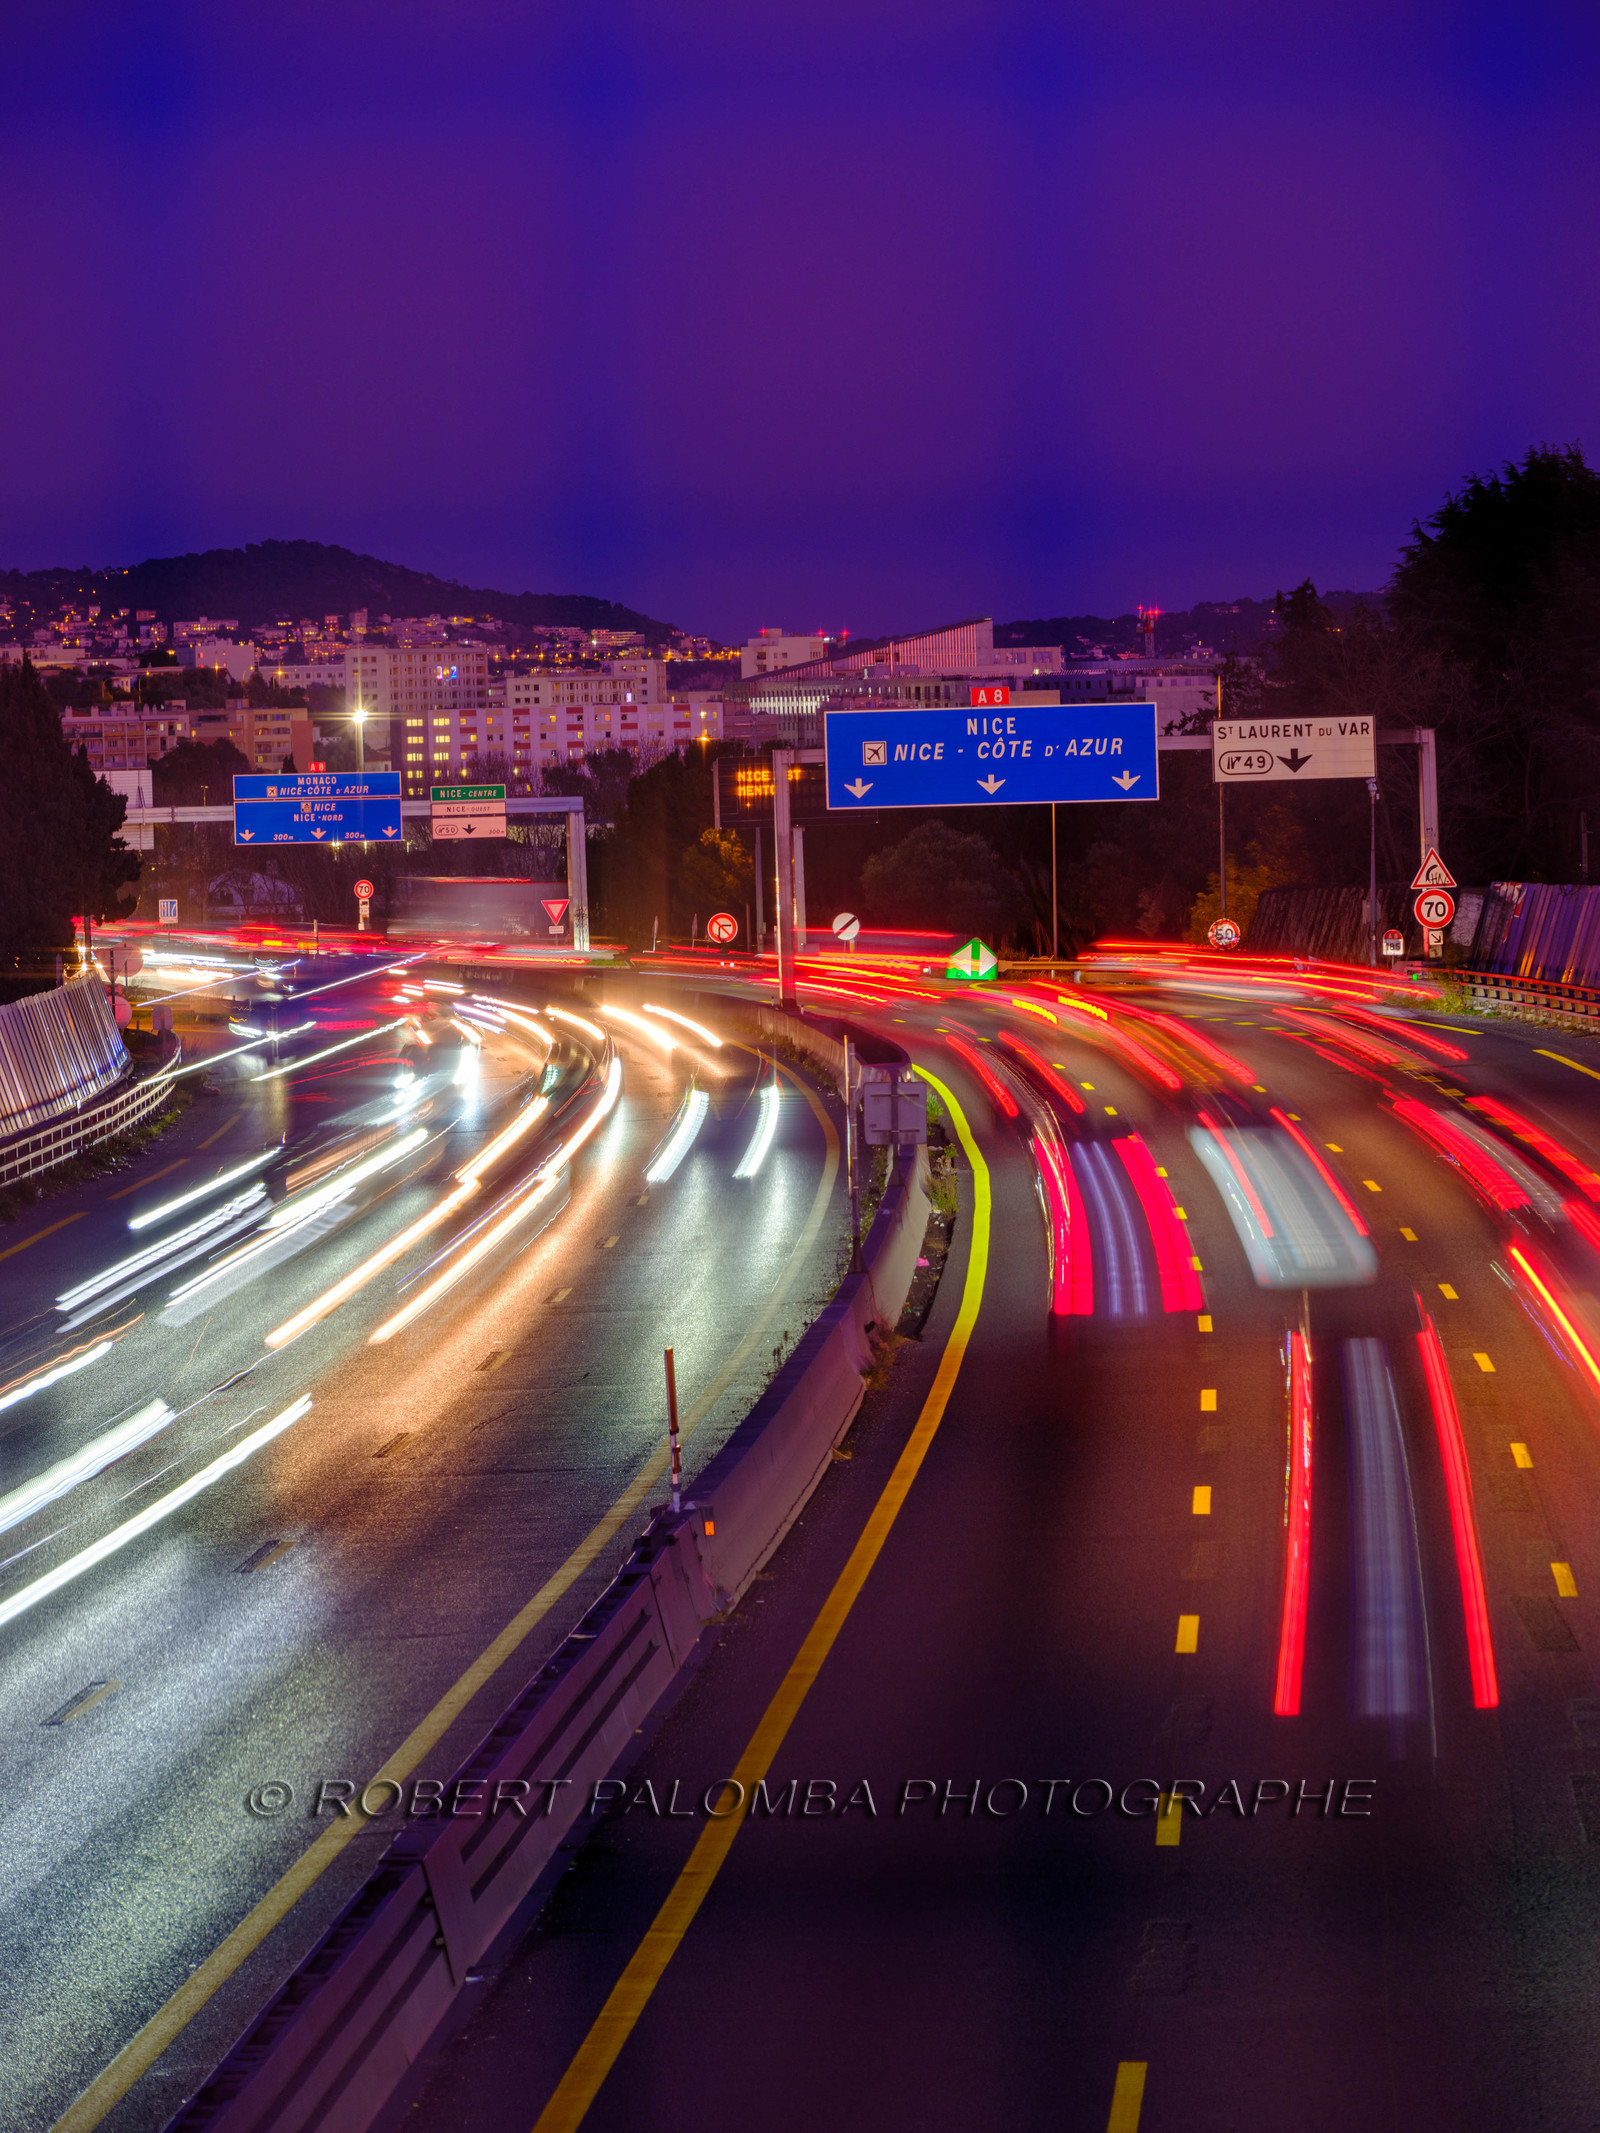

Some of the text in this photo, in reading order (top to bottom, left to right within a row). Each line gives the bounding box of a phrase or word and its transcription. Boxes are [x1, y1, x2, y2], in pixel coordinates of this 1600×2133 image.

[966, 717, 1017, 735] NICE
[1239, 724, 1313, 739] LAURENT
[1318, 727, 1332, 737] DU
[1338, 722, 1370, 736] VAR
[894, 743, 945, 762] NICE
[977, 738, 1033, 759] CÔTE
[1243, 755, 1266, 769] 49
[297, 776, 337, 785] MONACO
[738, 770, 770, 782] NICE
[738, 784, 776, 796] MENTO
[313, 803, 337, 812] NICE
[359, 885, 370, 894] 70
[1424, 901, 1446, 918] 70
[1215, 928, 1234, 940] 50
